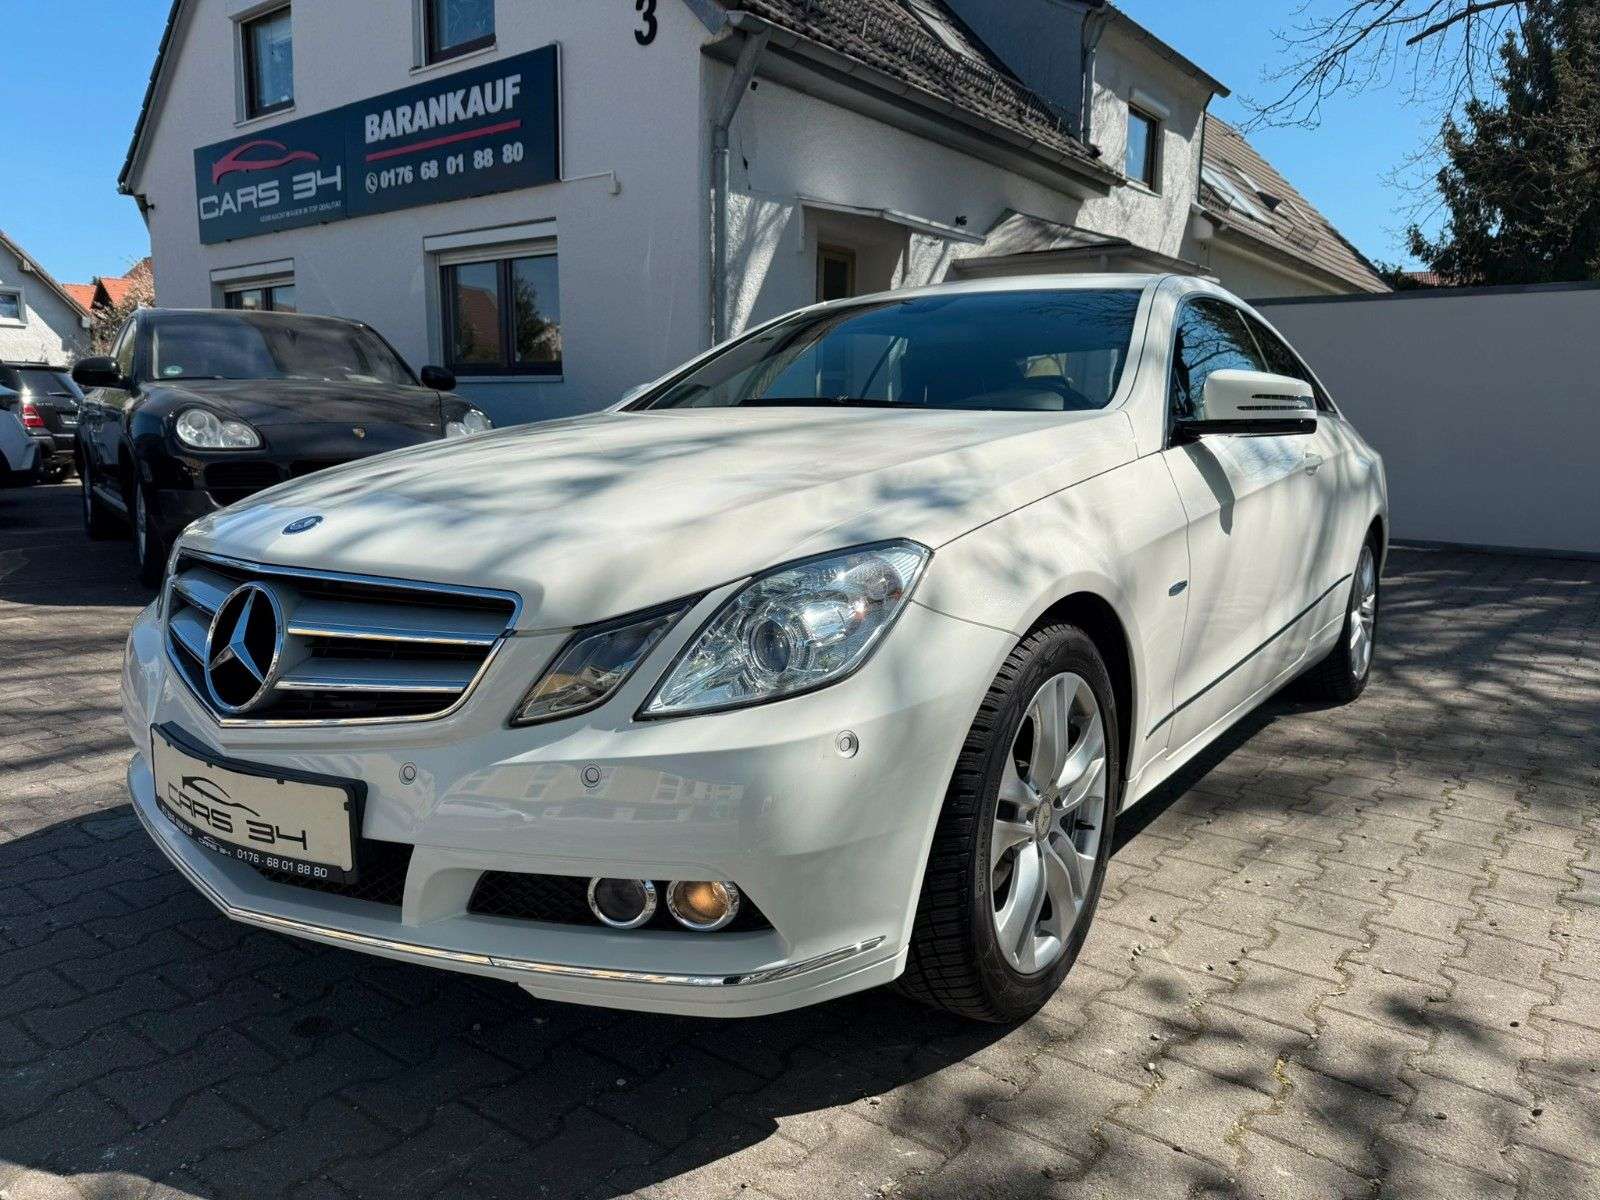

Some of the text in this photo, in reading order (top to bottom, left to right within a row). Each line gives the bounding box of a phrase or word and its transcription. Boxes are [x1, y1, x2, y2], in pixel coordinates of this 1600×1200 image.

[634, 0, 658, 46] 3
[364, 73, 522, 144] BARANKAUF
[380, 141, 524, 189] 0176 68 01 88 80
[200, 165, 342, 220] CARS 34
[167, 782, 234, 834] CARS
[246, 819, 308, 851] 34
[237, 848, 259, 864] 0176
[267, 856, 279, 868] 68
[281, 860, 294, 872] 01
[297, 863, 311, 875] 88
[314, 866, 328, 878] 80
